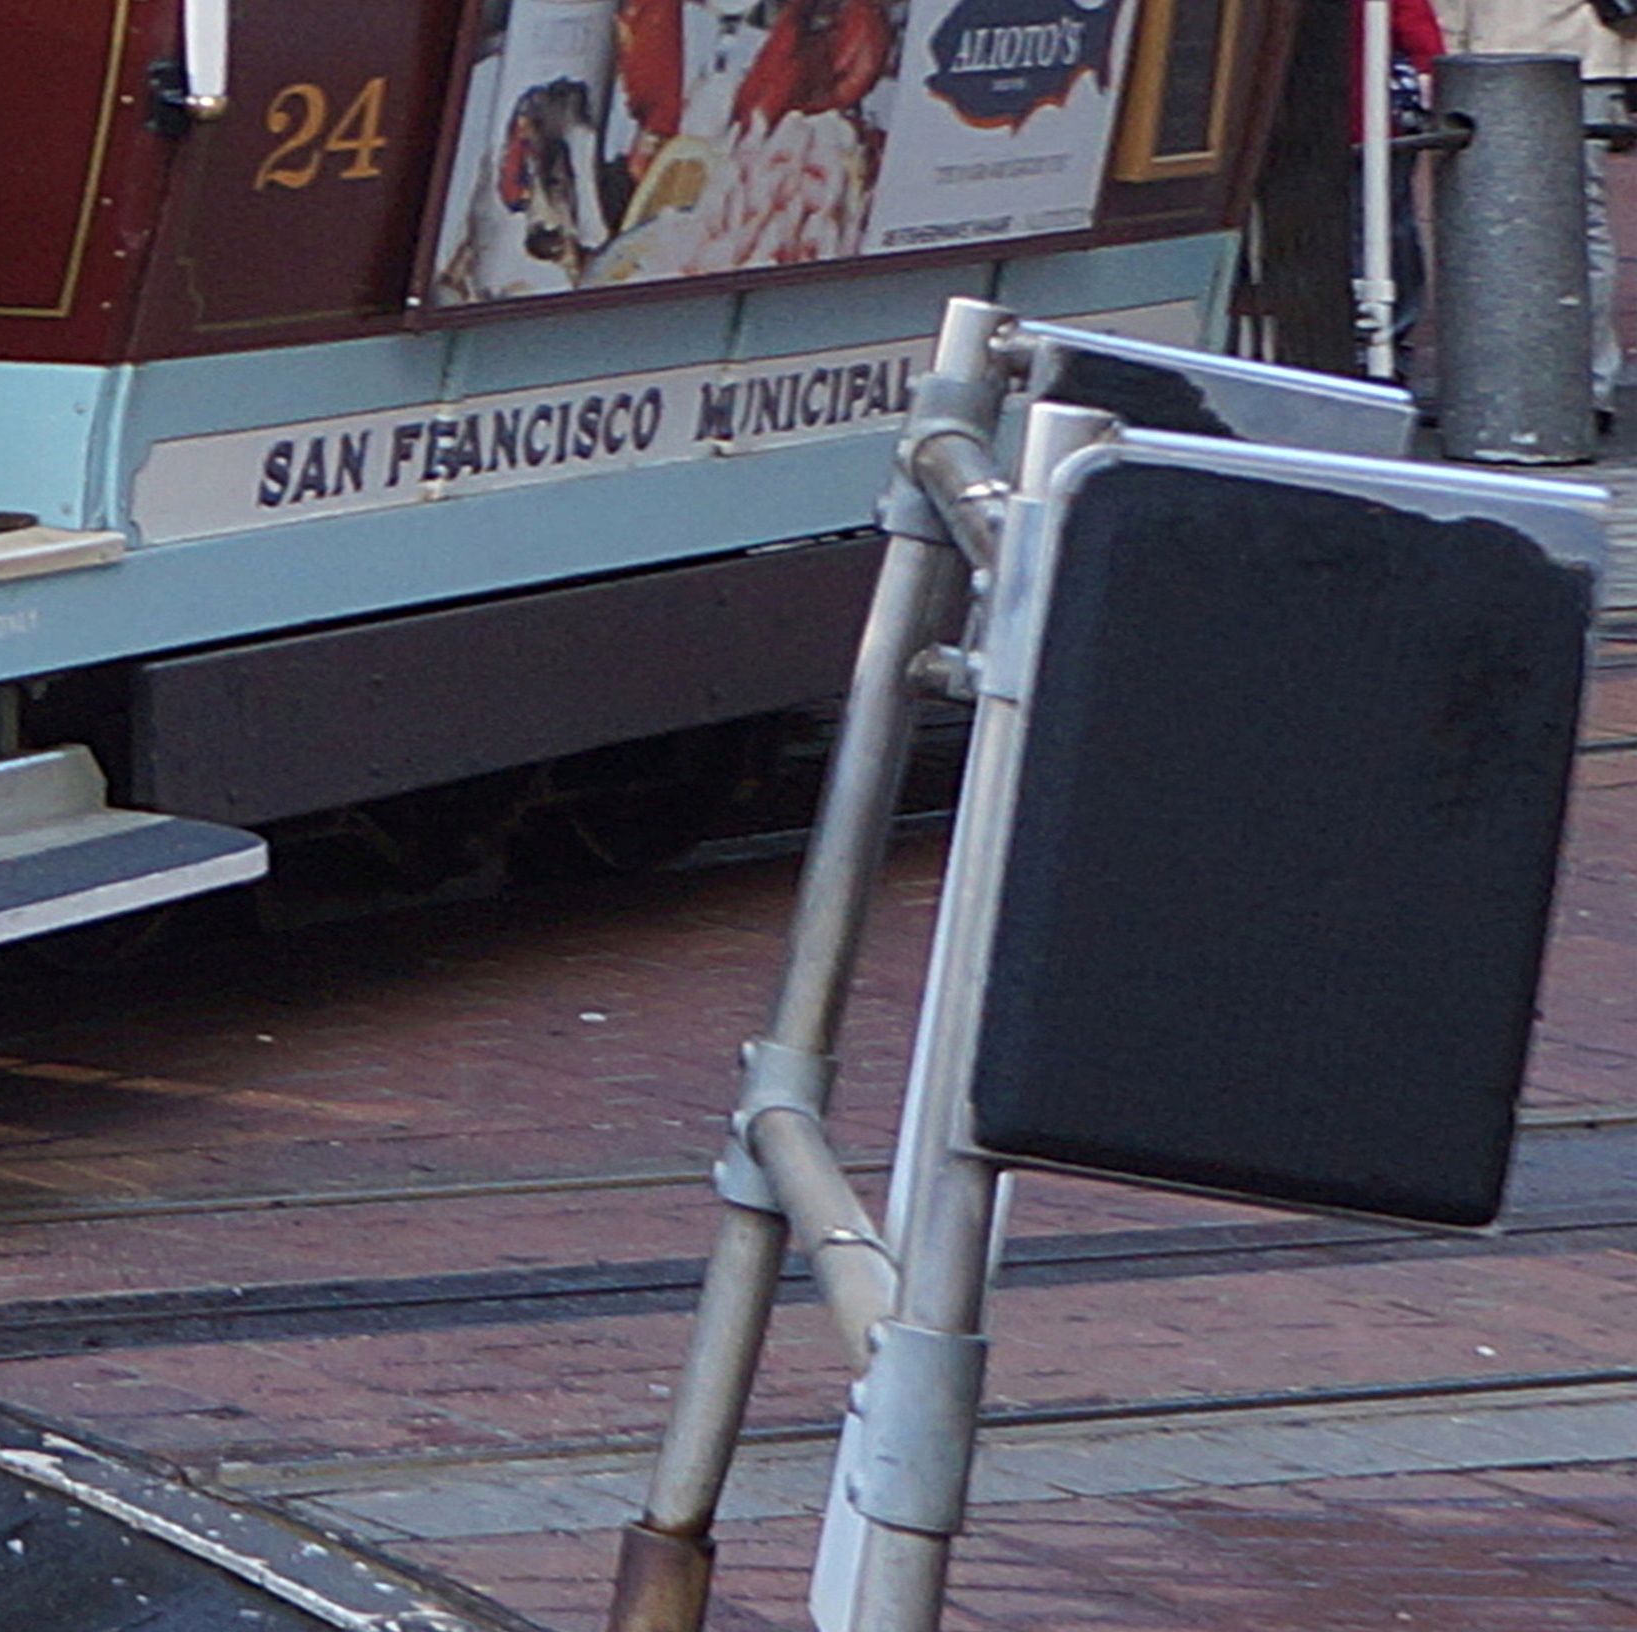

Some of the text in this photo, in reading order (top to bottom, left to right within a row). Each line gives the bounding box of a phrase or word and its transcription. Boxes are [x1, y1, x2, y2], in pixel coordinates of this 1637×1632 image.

[951, 16, 1086, 73] ALIOTO'S
[253, 76, 389, 191] 24
[255, 429, 371, 507] SAN
[384, 386, 663, 488] FRANCISCO
